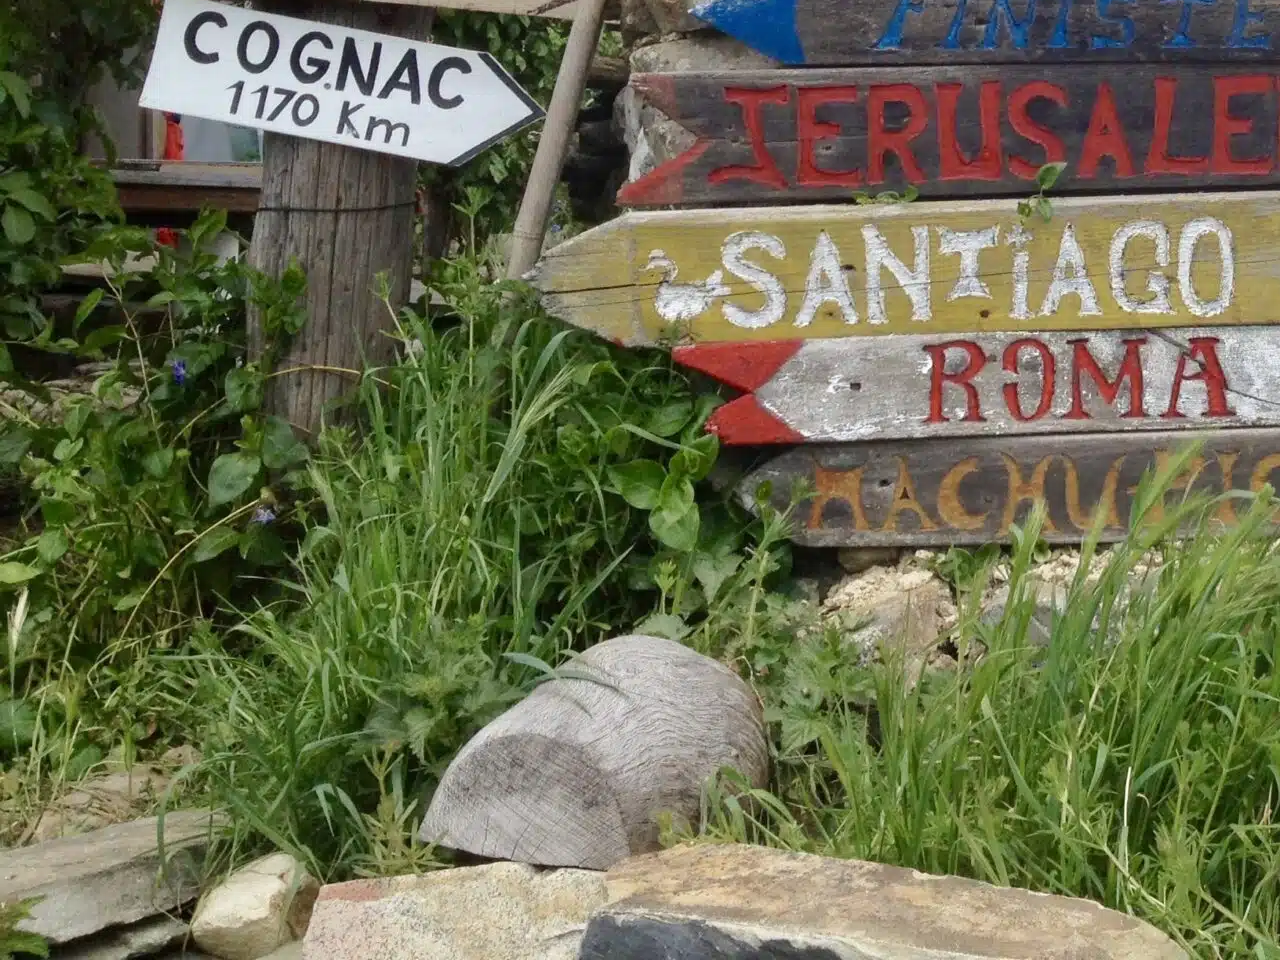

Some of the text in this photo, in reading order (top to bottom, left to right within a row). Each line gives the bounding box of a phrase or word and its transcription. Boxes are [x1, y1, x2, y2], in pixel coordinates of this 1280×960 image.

[184, 11, 473, 109] COGNAC
[226, 80, 410, 147] 1170 Km
[922, 336, 1236, 424] ROMA
